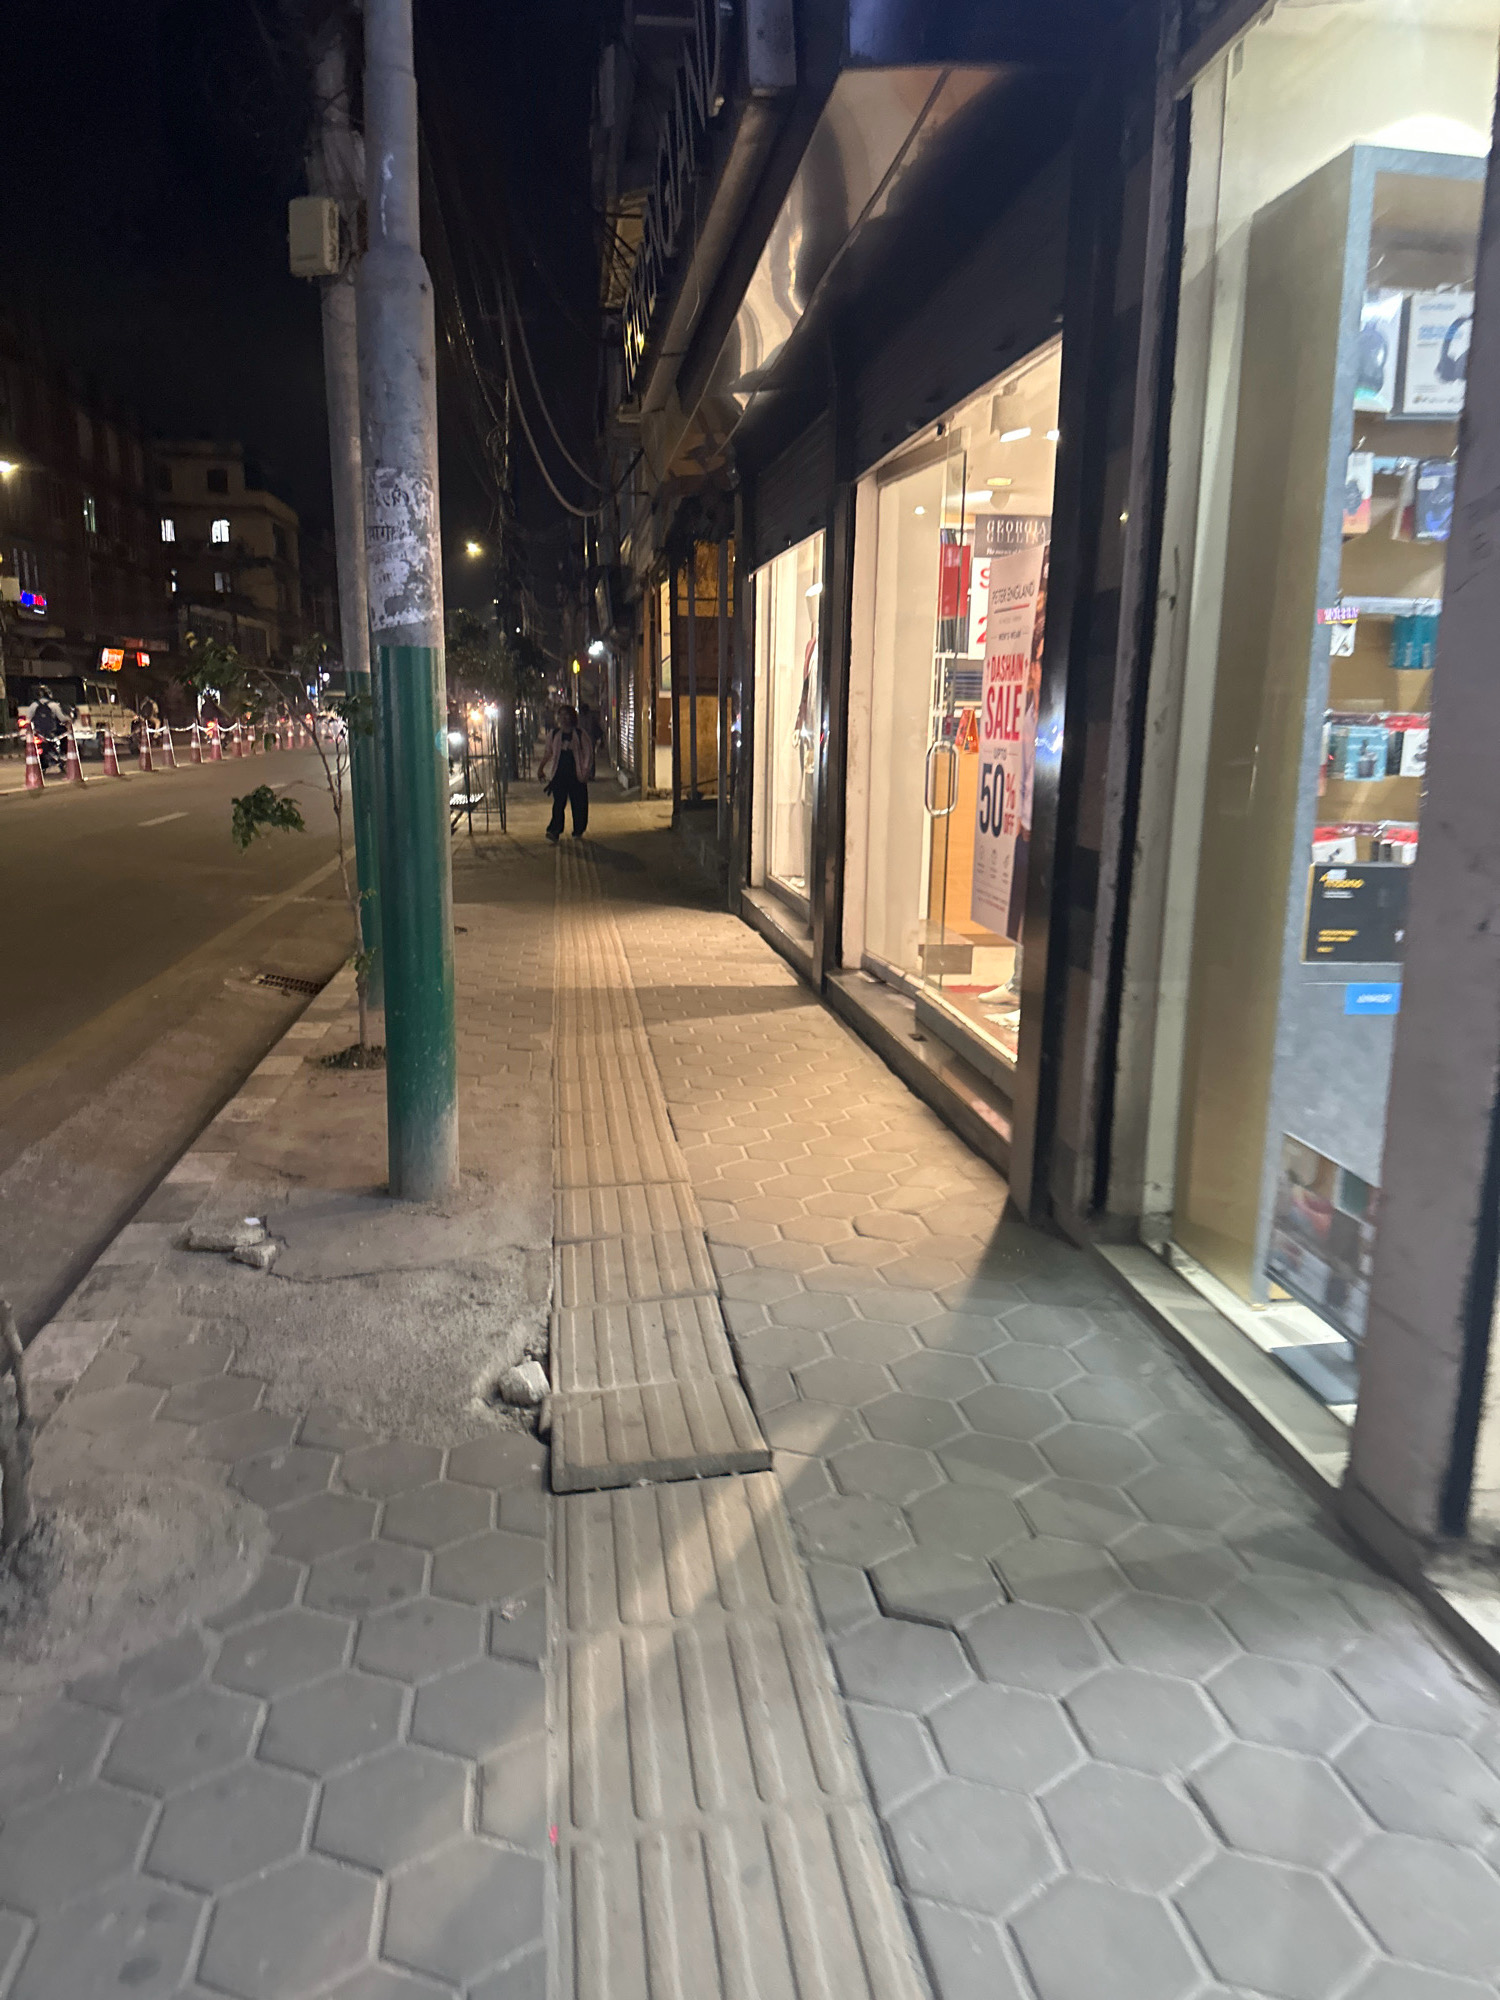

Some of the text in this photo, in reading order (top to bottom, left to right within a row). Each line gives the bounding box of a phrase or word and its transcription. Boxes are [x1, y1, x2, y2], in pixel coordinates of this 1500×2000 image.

[986, 519, 1046, 534] GEORGIA
[1007, 581, 1035, 602] ENGLAND
[991, 653, 1024, 682] DASHAIN
[985, 684, 1022, 742] SALE
[1003, 812, 1015, 835] OFF
